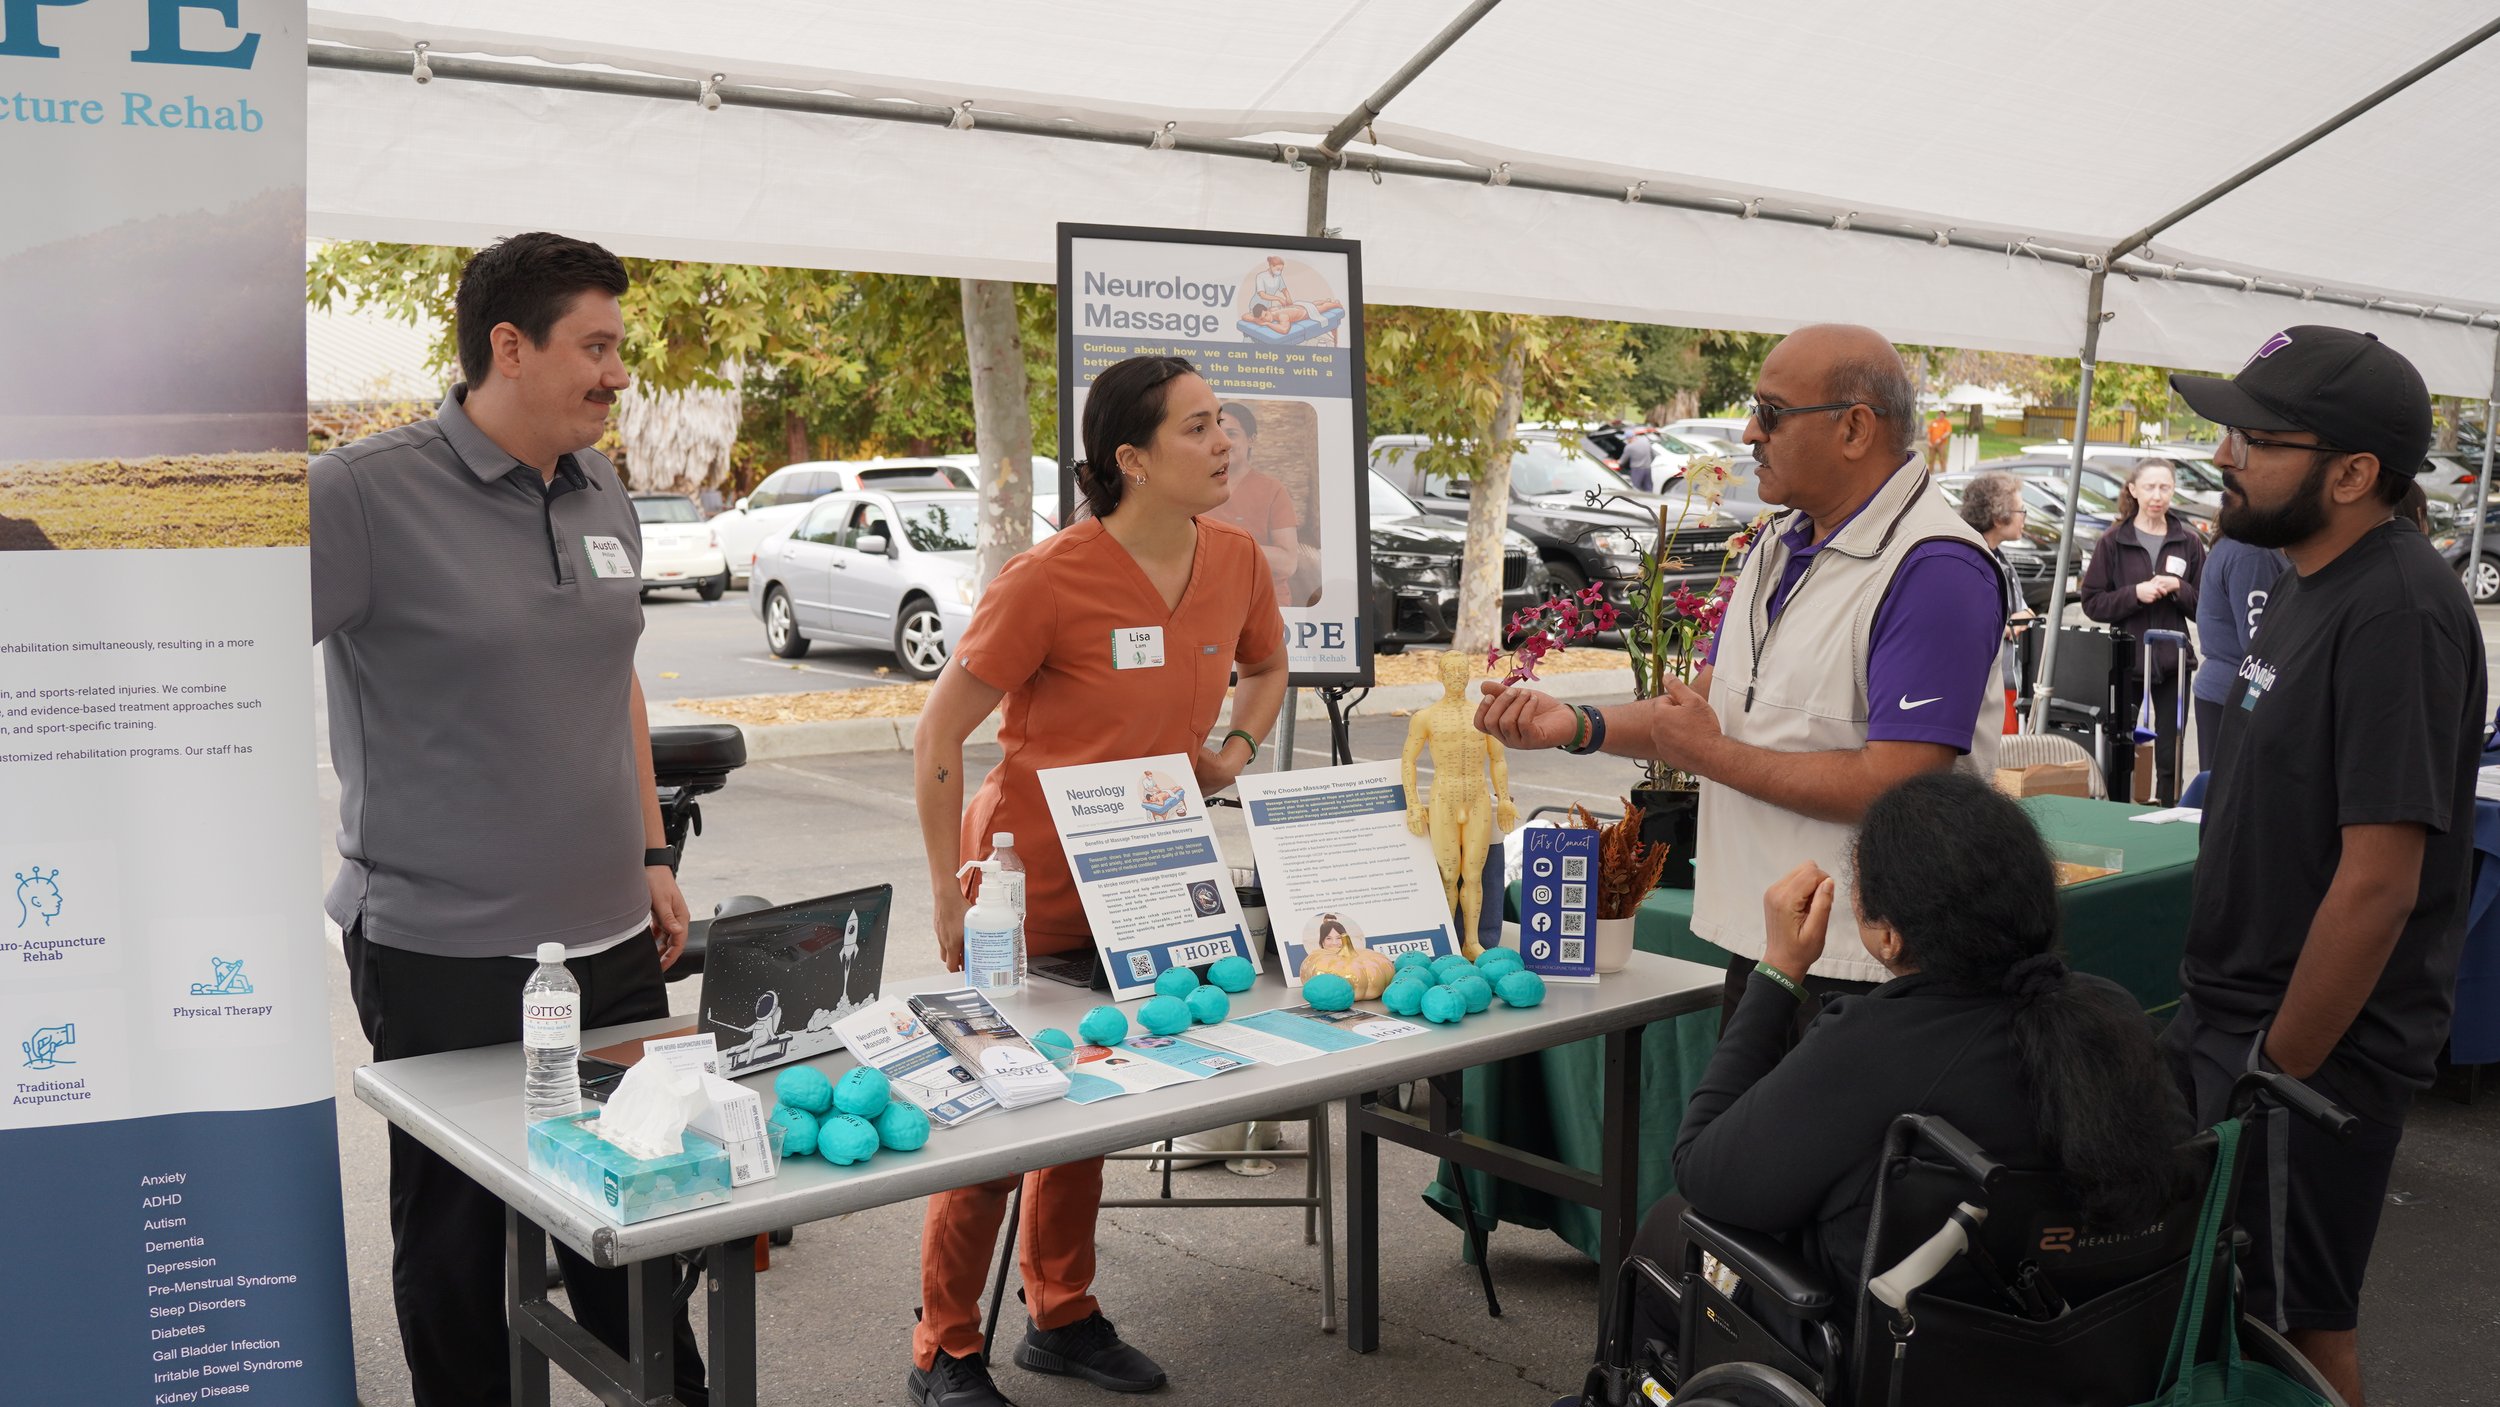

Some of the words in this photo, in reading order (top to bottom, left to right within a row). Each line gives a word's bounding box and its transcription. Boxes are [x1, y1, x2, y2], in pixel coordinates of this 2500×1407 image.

[121, 92, 264, 132] Rehab
[1084, 271, 1236, 307] Neurology
[1084, 303, 1219, 337] Massage
[1084, 343, 1126, 354] Curious
[1134, 345, 1166, 355] about
[1174, 347, 1196, 357] how
[1204, 350, 1220, 358] we
[1228, 351, 1248, 359] can
[1255, 350, 1278, 362] help
[1286, 354, 1305, 364] you
[1312, 353, 1332, 363] feel
[1210, 362, 1229, 372] the
[1238, 363, 1284, 375] benefits
[1293, 366, 1318, 376] with
[1223, 380, 1276, 389] massage.
[592, 540, 619, 551] Austin
[1129, 632, 1151, 642] Lisa
[0, 642, 69, 654] ehabilitation
[72, 640, 155, 652] simultaneously,
[157, 639, 202, 650] resulting
[205, 639, 215, 648] in
[227, 638, 254, 648] more
[1319, 654, 1346, 662] Rehab
[15, 687, 36, 699] and
[40, 686, 116, 700] sports-related
[119, 684, 159, 696] injuries.
[162, 684, 178, 694] We
[181, 683, 226, 694] combine
[7, 706, 28, 716] and
[31, 703, 116, 716] evidence-based
[119, 702, 169, 712] treatment
[172, 700, 234, 713] approaches
[237, 699, 261, 709] such
[13, 723, 34, 734] and
[37, 720, 111, 735] sport-specific
[114, 719, 156, 730] training.
[56, 747, 127, 760] rehabilitation
[130, 747, 182, 759] programs.
[185, 746, 203, 756] Our
[206, 744, 231, 755] staff
[234, 744, 253, 754] has
[1066, 785, 1125, 801] Neurology
[1303, 783, 1330, 792] Massage
[1331, 780, 1357, 789] Therapy
[1071, 801, 1124, 817] Massage
[1531, 831, 1552, 851] Let's
[1555, 832, 1594, 853] Connect
[23, 950, 63, 962] Rehab
[1185, 940, 1231, 960] HOPE
[1389, 941, 1429, 955] HOPE
[1766, 968, 1776, 977] LIFE
[1780, 977, 1794, 989] GOLF
[173, 1006, 222, 1019] Physical
[224, 1004, 272, 1017] Therapy
[855, 1026, 887, 1042] Neurology
[1371, 1025, 1416, 1038] HOPE
[862, 1035, 892, 1051] Massage
[17, 1079, 85, 1093] Traditional
[13, 1090, 91, 1105] Acupuncture
[967, 1090, 986, 1102] HOP
[141, 1172, 186, 1186] Anxiety
[143, 1193, 182, 1209] ADHD
[144, 1217, 186, 1230] Autism
[146, 1236, 204, 1252] Dementia
[147, 1257, 216, 1275] Depression
[149, 1277, 233, 1296] Pre-Menstrual
[237, 1273, 297, 1287] Syndrome
[150, 1304, 185, 1318] Sleep
[189, 1298, 246, 1313] Disorders
[152, 1324, 205, 1340] Diabetes
[153, 1349, 177, 1362] Gall
[181, 1342, 227, 1358] Bladder
[231, 1338, 280, 1350] Infection
[154, 1368, 199, 1383] Irritable
[203, 1362, 239, 1376] Bowel
[243, 1358, 303, 1371] Syndrome
[156, 1390, 197, 1405] Kidney
[202, 1384, 250, 1398] Disease
